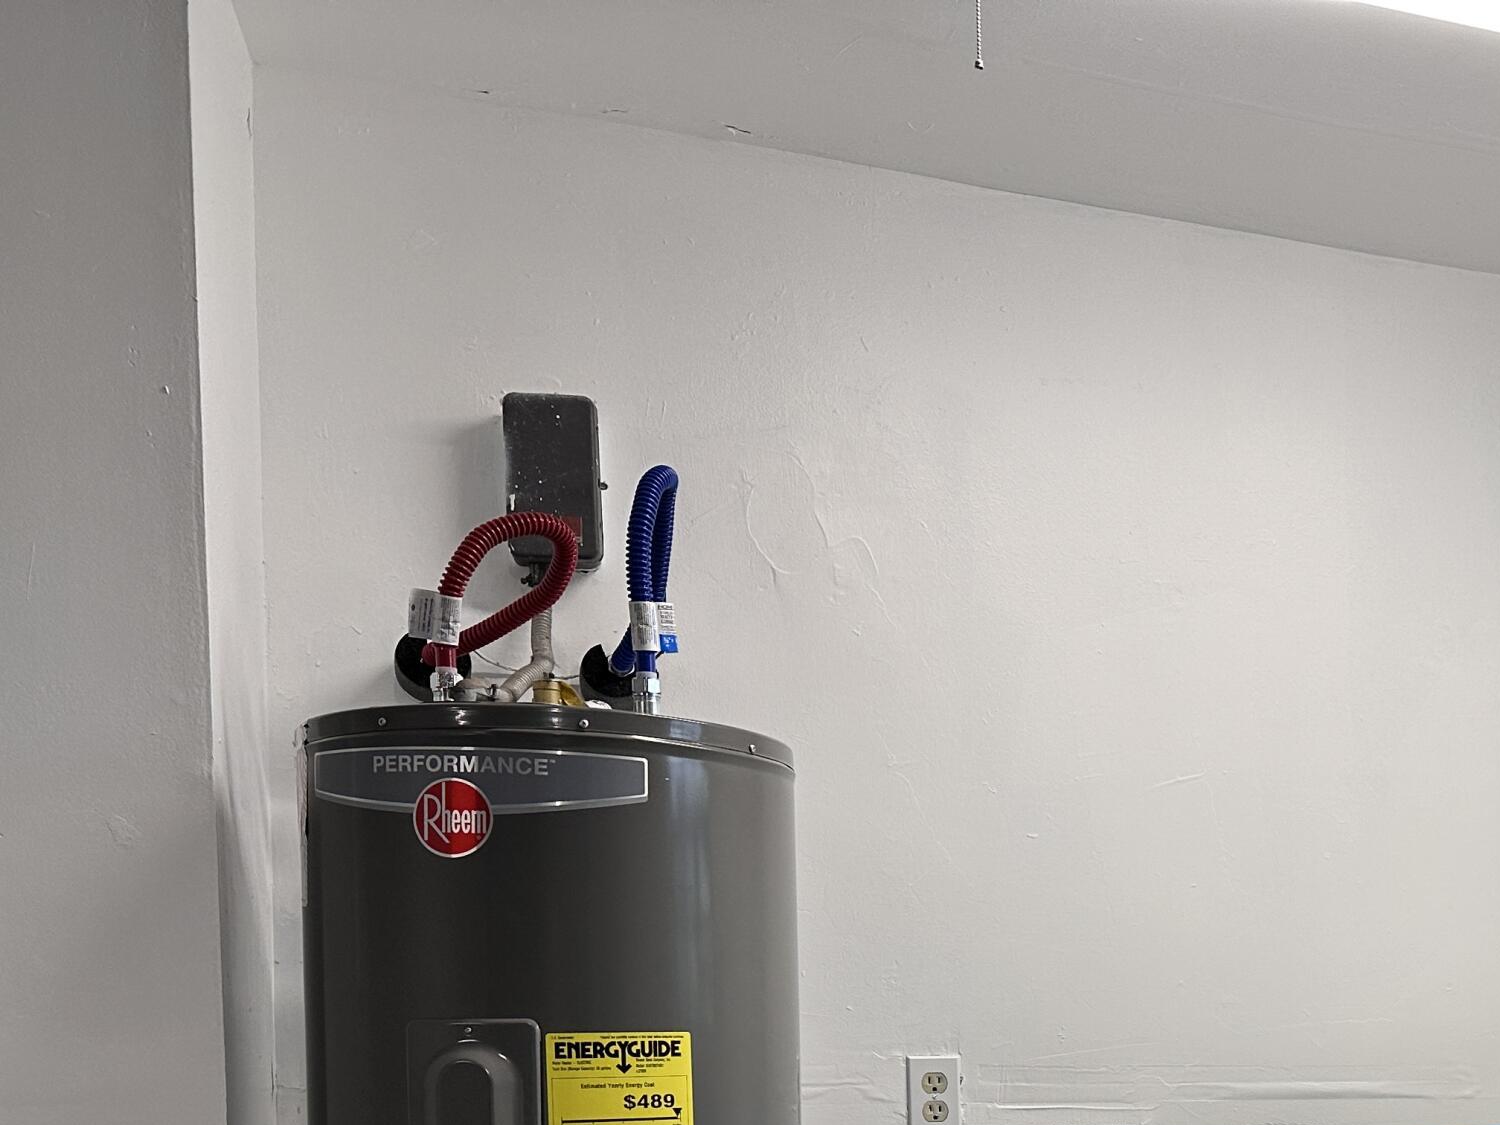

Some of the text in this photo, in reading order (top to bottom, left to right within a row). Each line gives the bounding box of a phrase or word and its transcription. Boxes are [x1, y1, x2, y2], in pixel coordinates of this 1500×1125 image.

[373, 755, 549, 775] PERFORMANCE
[423, 781, 487, 844] Rheem
[555, 1041, 681, 1063] ENERGYGUIDE
[623, 1094, 675, 1110] $489
